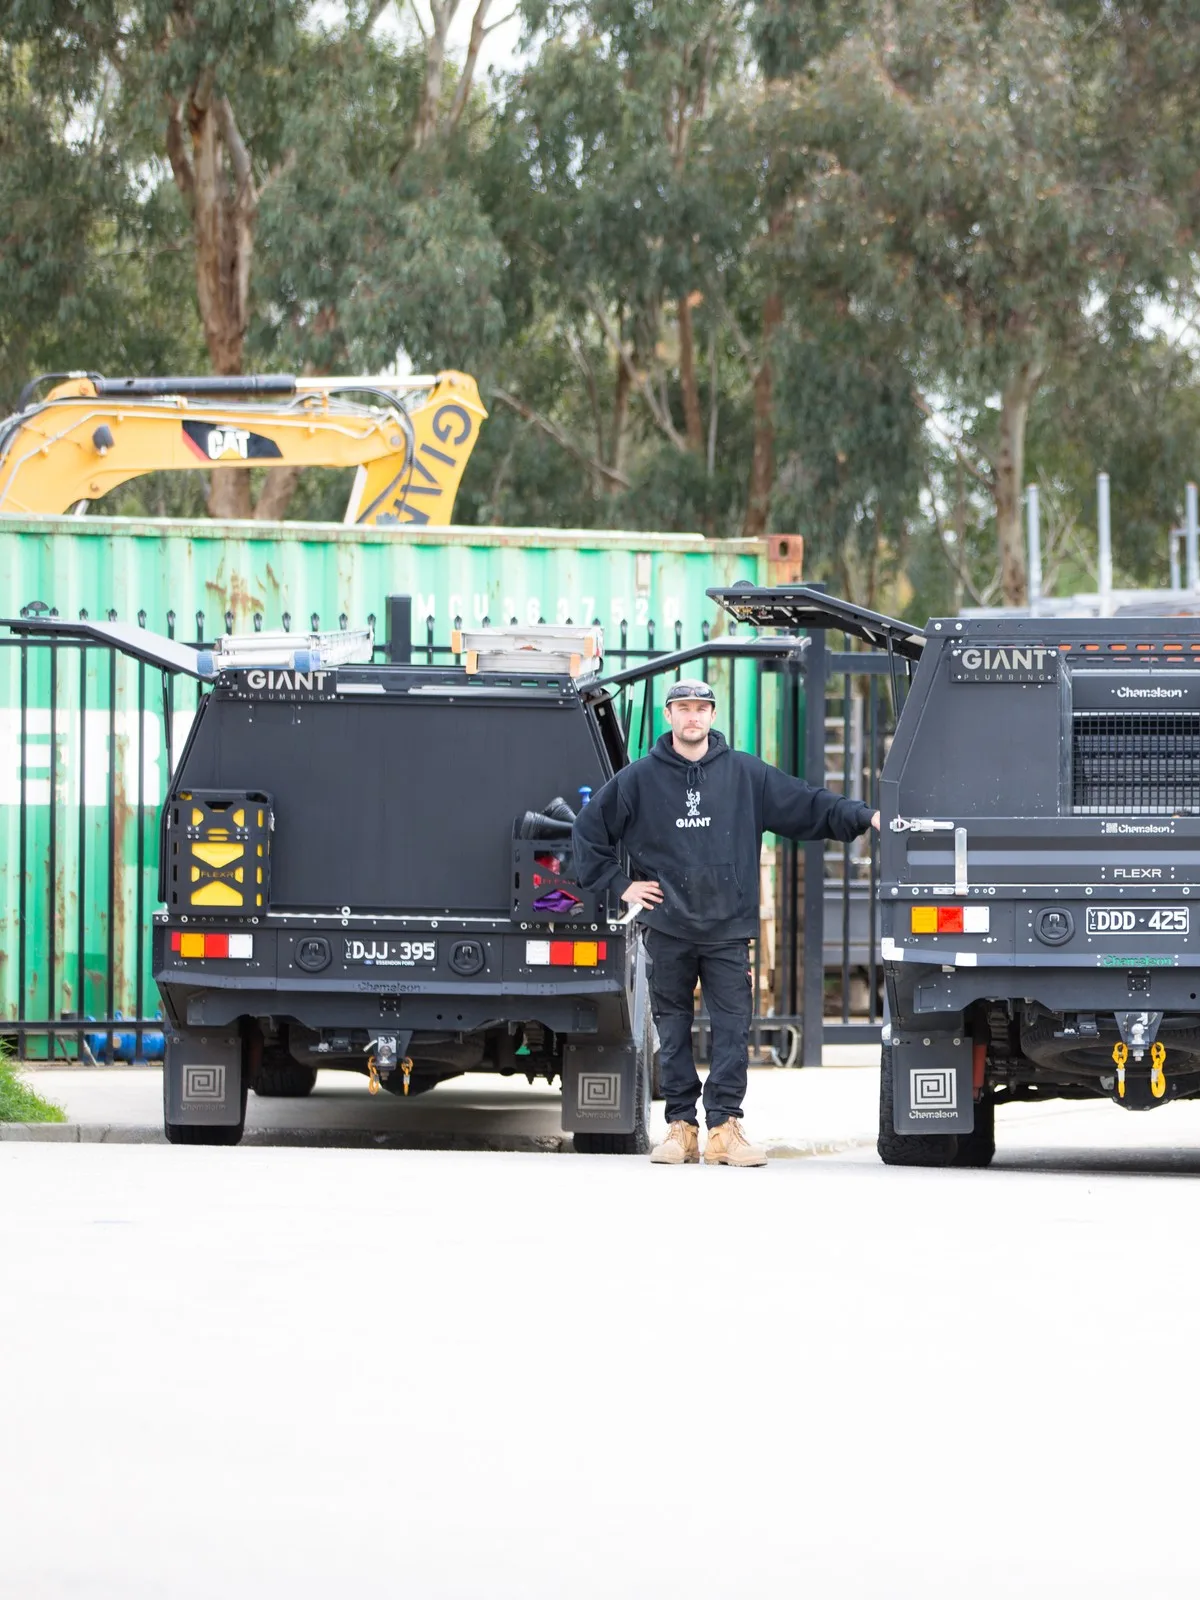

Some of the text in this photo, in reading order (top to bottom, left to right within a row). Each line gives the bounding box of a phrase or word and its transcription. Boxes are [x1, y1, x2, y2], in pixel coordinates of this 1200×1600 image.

[208, 430, 250, 459] CAT
[962, 649, 1047, 670] GIANT
[247, 670, 327, 690] GIANT
[249, 693, 325, 701] PLUMBING
[1117, 686, 1182, 697] Chameleon
[676, 817, 711, 828] GIANT
[1118, 824, 1170, 833] Chameleon
[201, 870, 234, 878] FLEXR
[1114, 868, 1162, 878] FLEXR
[1104, 955, 1172, 966] Chameleon
[358, 981, 421, 992] Chameleon
[909, 1110, 958, 1118] Chameleon
